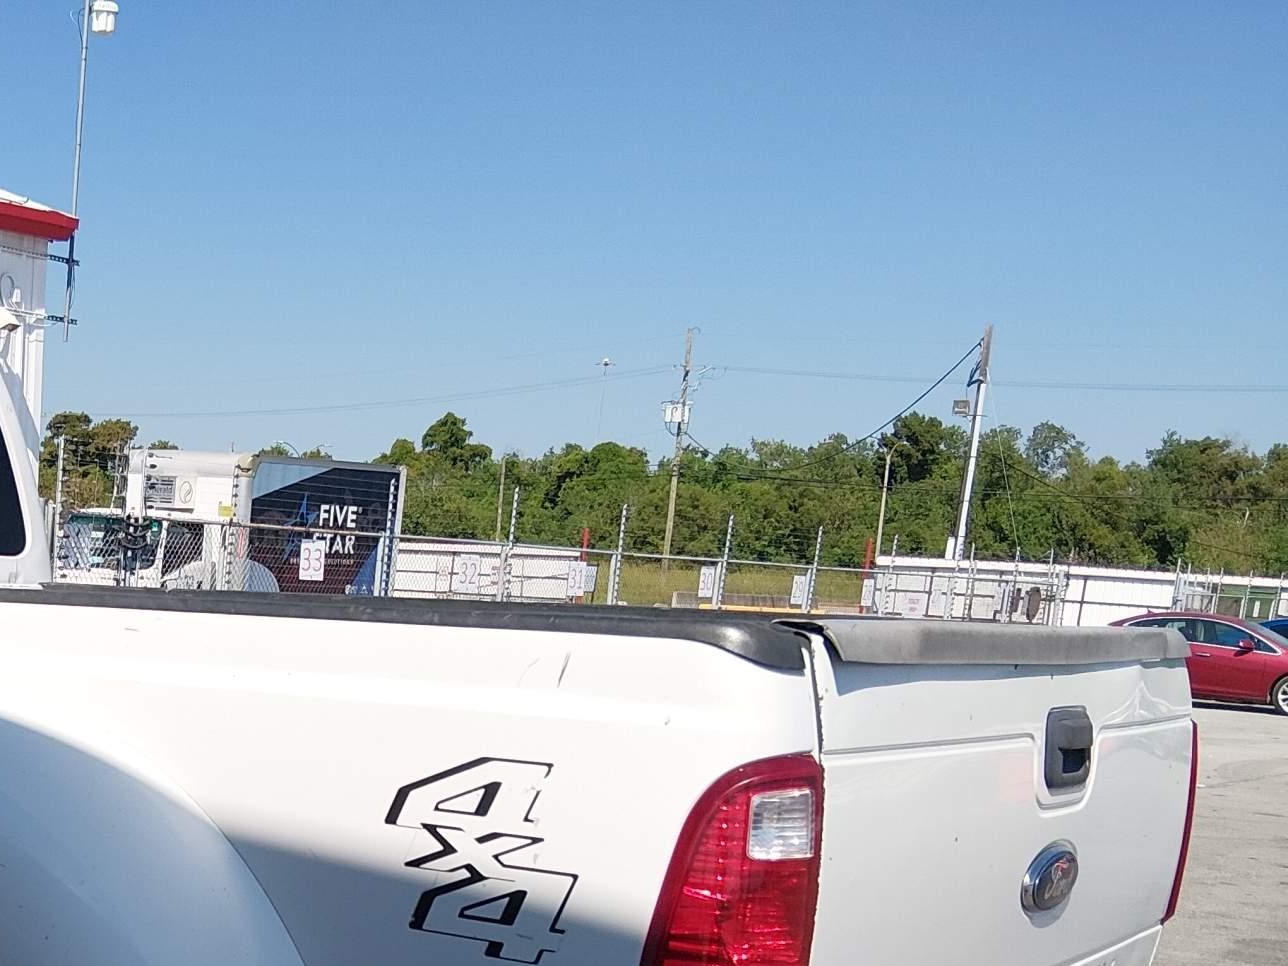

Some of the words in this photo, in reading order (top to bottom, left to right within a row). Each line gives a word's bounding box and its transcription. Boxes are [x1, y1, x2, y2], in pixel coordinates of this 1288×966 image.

[319, 504, 358, 528] FIVE
[301, 547, 322, 571] 33
[459, 562, 477, 584] 32
[569, 568, 583, 589] 31
[699, 572, 713, 590] 30
